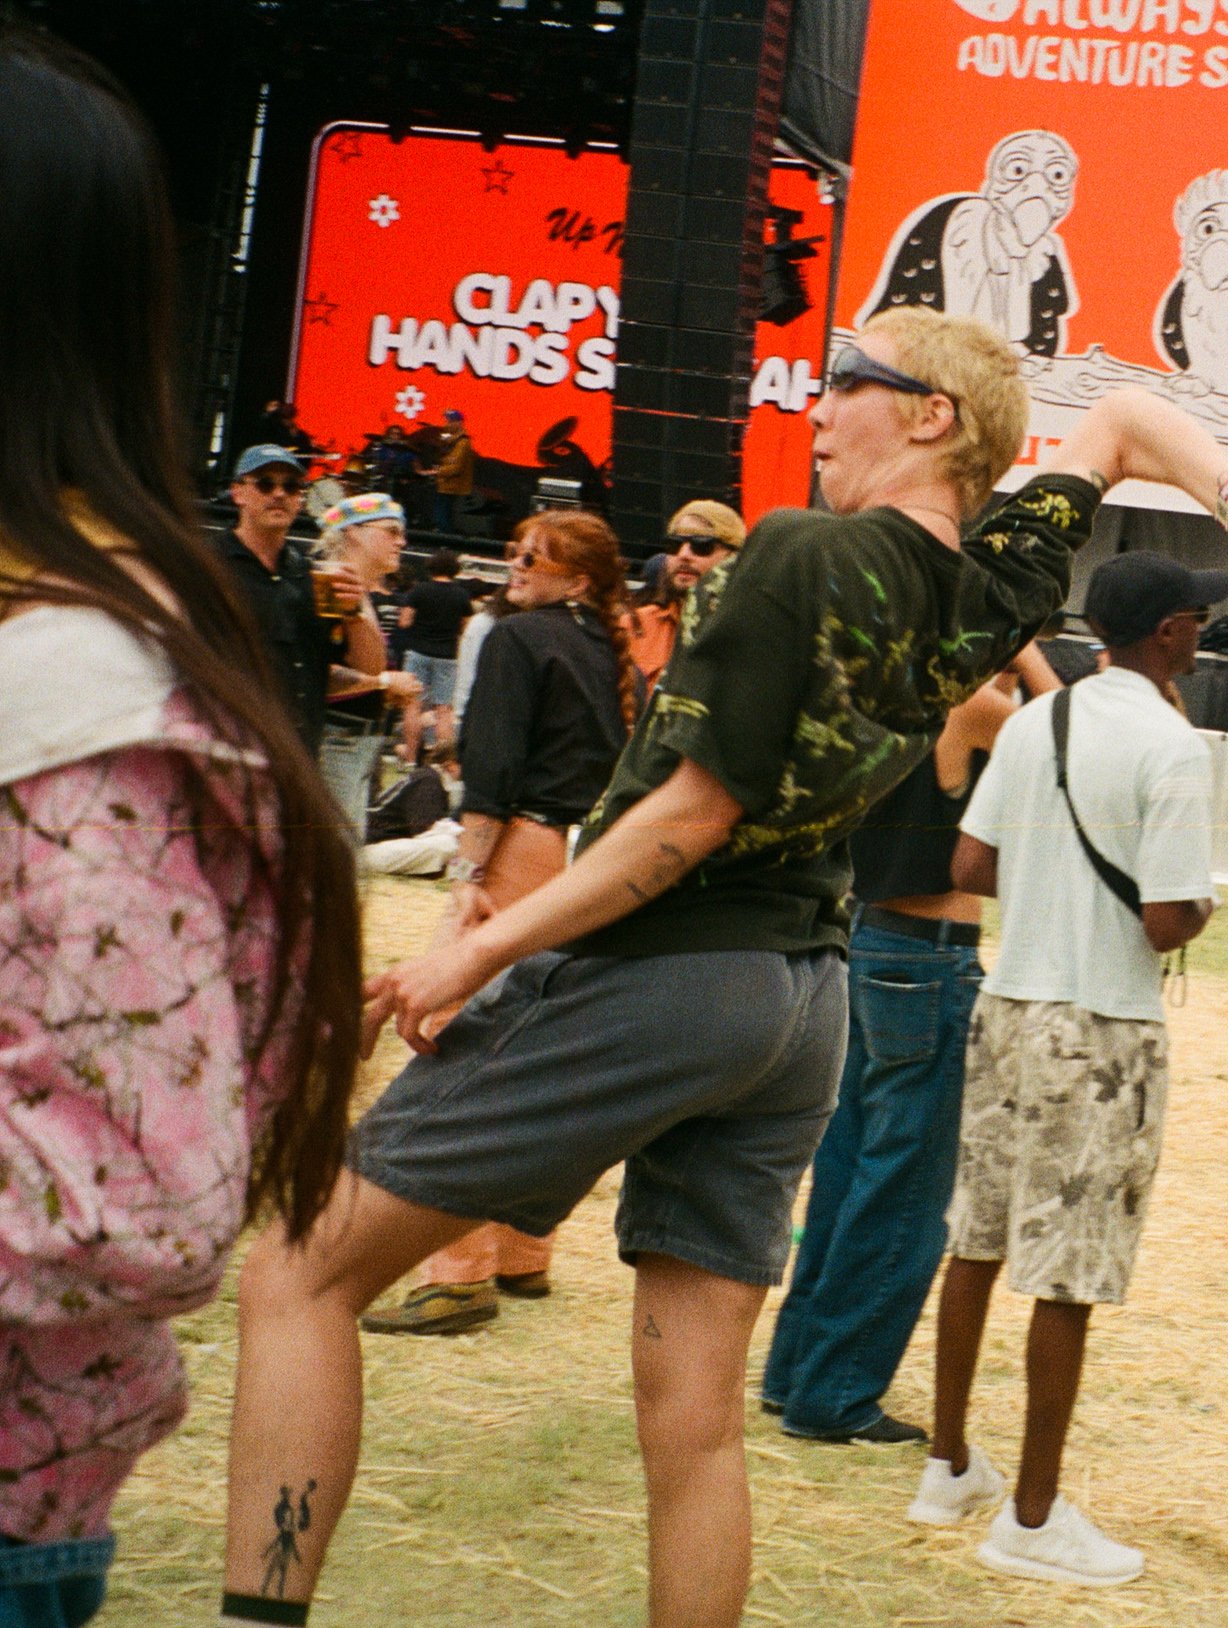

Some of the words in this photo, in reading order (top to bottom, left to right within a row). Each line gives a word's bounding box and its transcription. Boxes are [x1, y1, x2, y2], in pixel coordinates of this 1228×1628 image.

[956, 33, 1194, 88] ADVENTURE
[546, 207, 597, 250] Up
[369, 314, 570, 385] HANDS
